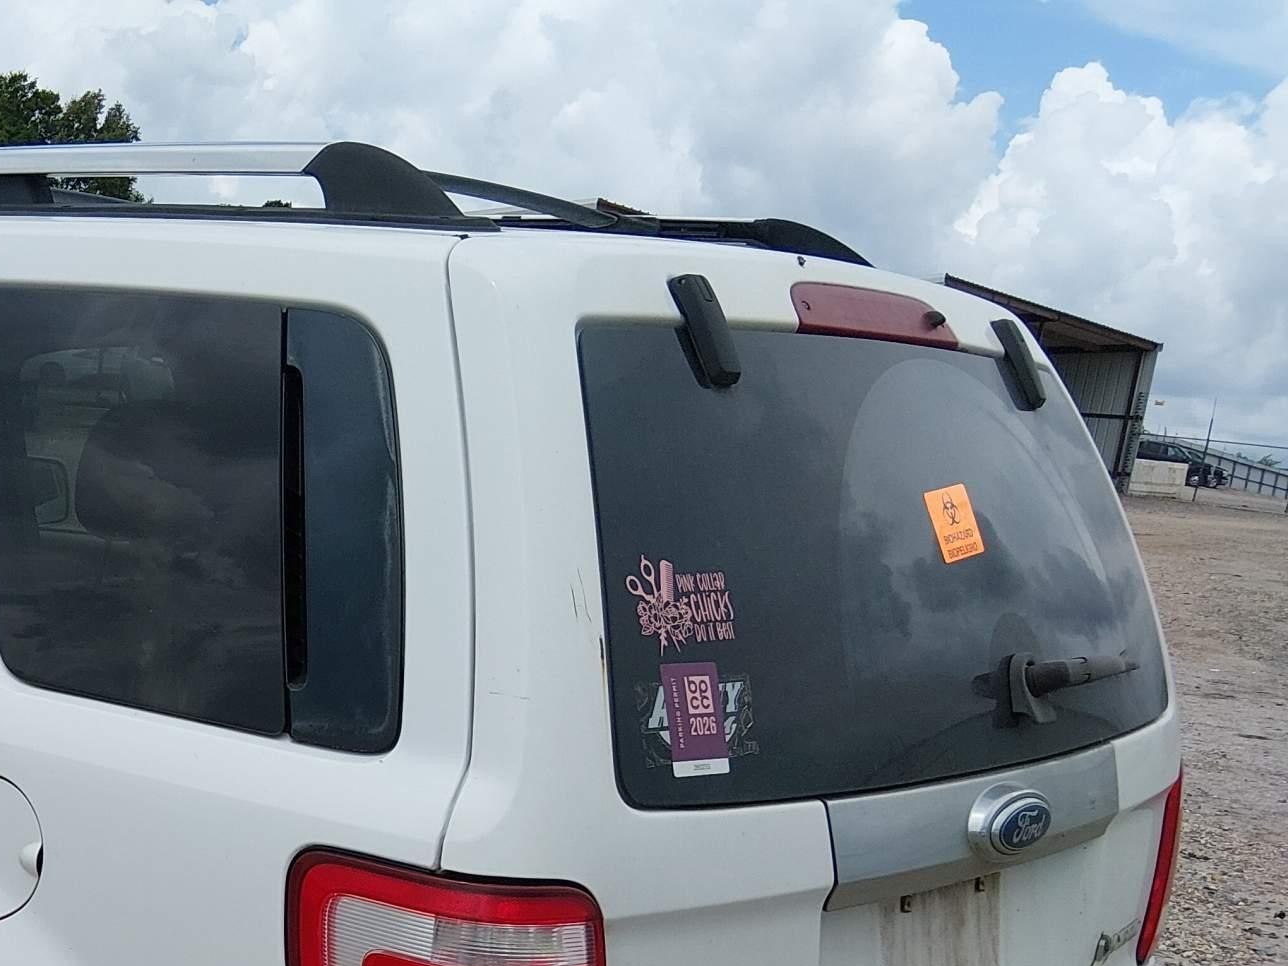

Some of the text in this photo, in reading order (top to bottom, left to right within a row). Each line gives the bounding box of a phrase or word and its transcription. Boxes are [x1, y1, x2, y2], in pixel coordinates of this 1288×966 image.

[694, 623, 708, 642] DO
[649, 684, 743, 727] AY
[670, 677, 681, 708] PERMIT
[689, 715, 718, 736] 2026
[1011, 809, 1047, 844] Ford
